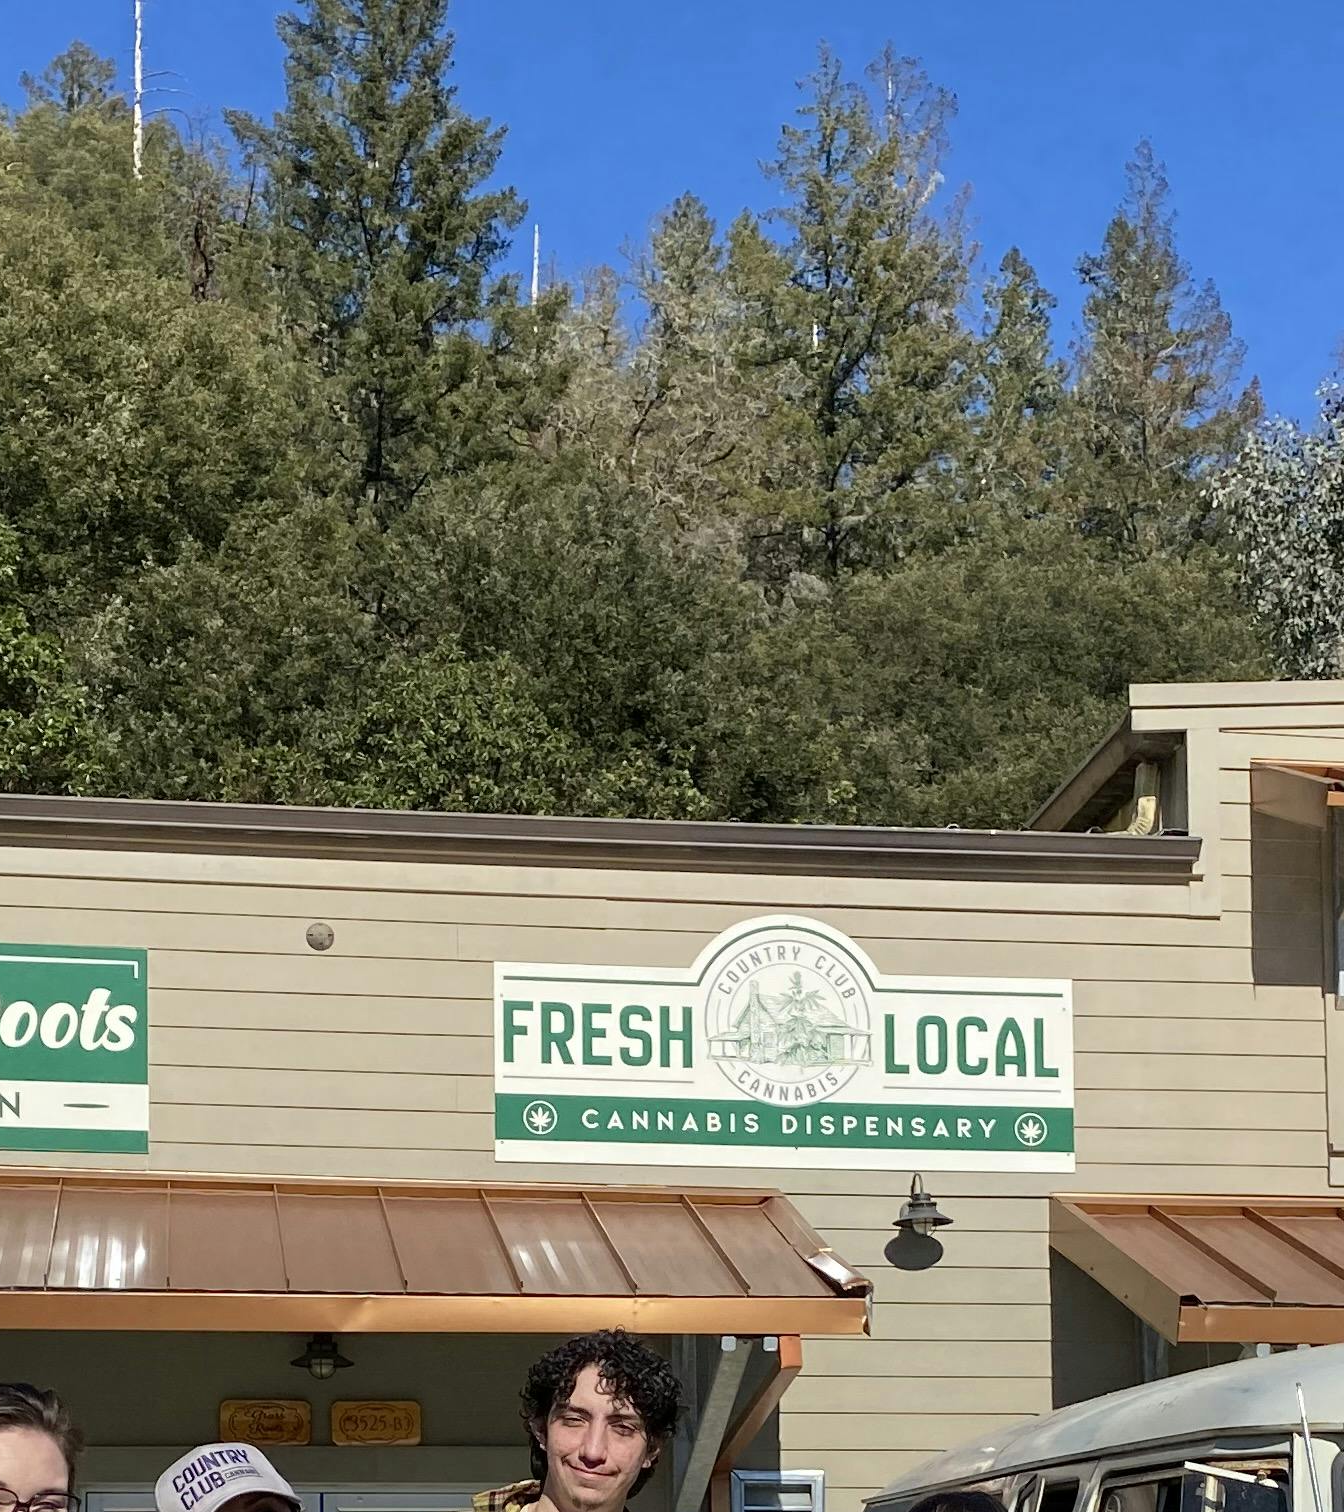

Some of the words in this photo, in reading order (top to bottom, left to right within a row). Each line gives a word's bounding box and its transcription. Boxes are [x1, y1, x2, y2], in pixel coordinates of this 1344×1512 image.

[718, 945, 801, 995] COUNTRY
[814, 955, 857, 999] CLUB
[502, 999, 694, 1070] FRESH
[884, 1013, 1059, 1078] LOCAL
[737, 1070, 838, 1102] CANNABIS
[581, 1108, 761, 1134] CANNABIS
[781, 1113, 997, 1140] DISPENSARY
[172, 1448, 251, 1493] COUNTRY
[180, 1471, 226, 1511] CLUB
